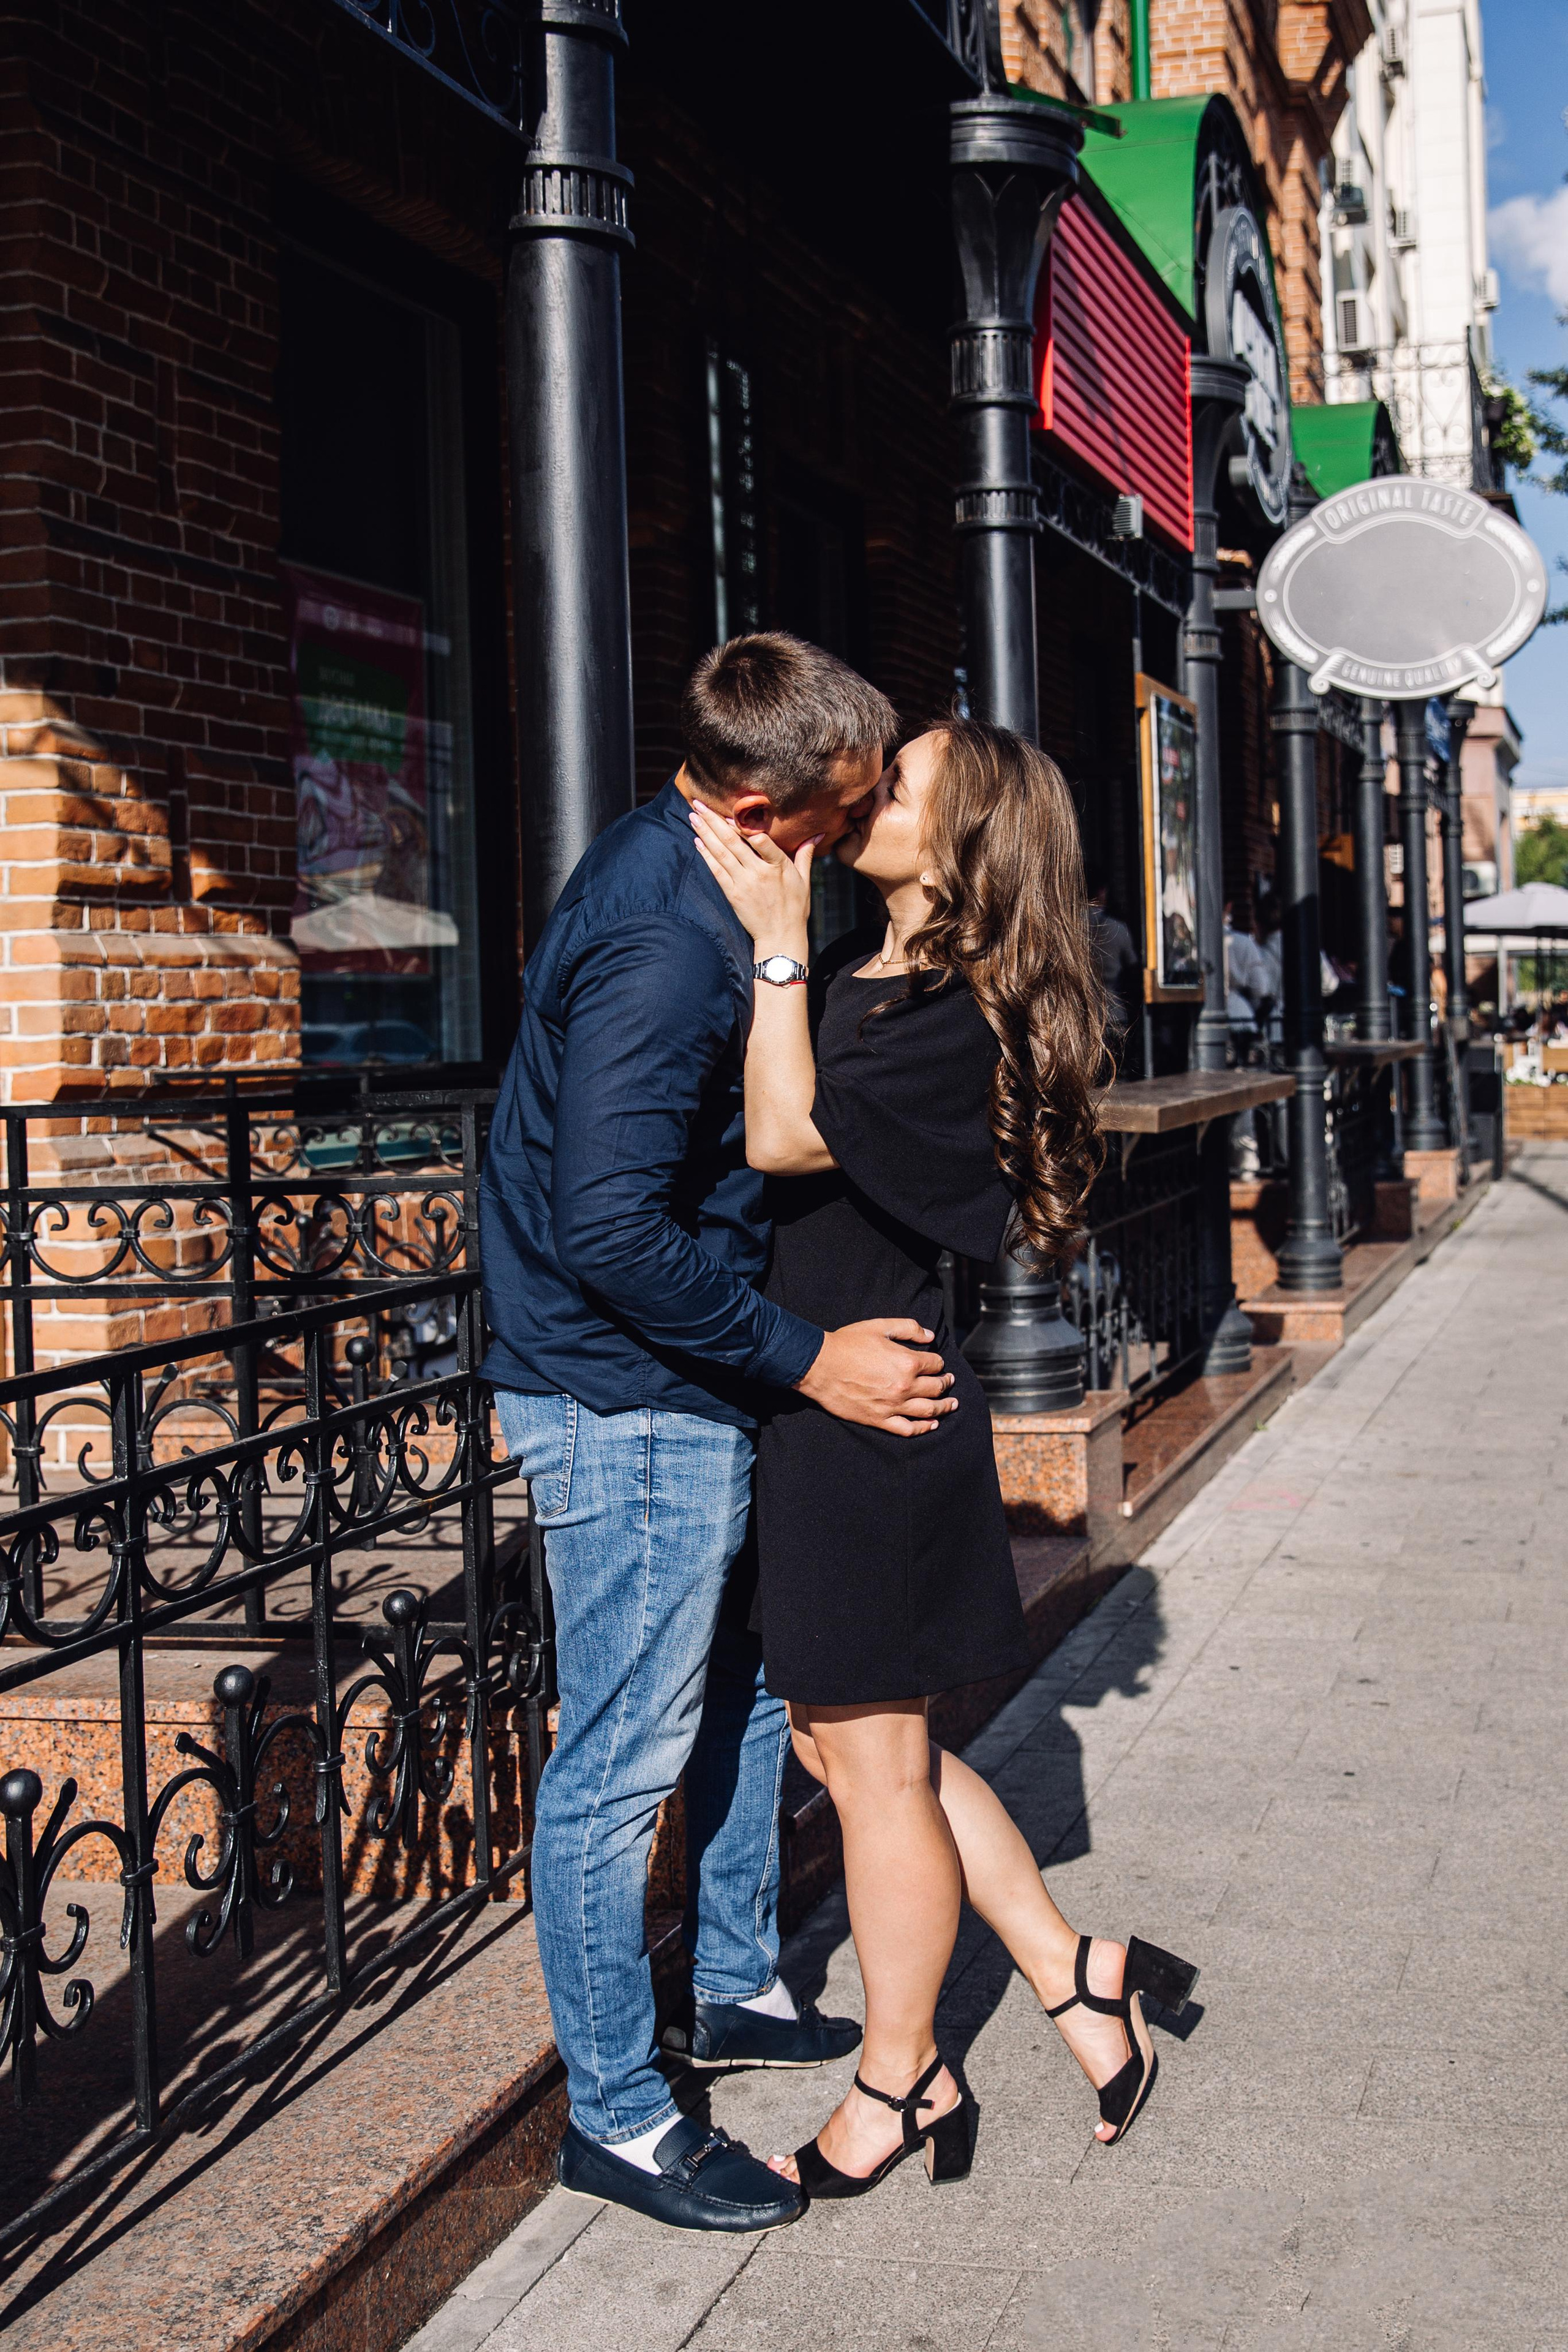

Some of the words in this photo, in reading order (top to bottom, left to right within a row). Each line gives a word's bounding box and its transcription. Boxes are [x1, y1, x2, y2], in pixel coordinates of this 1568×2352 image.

[1324, 486, 1413, 529] ORIGINAL
[1420, 487, 1474, 526] TASTE
[1341, 660, 1402, 687] GENUINE
[1404, 656, 1462, 690] QUALITY
